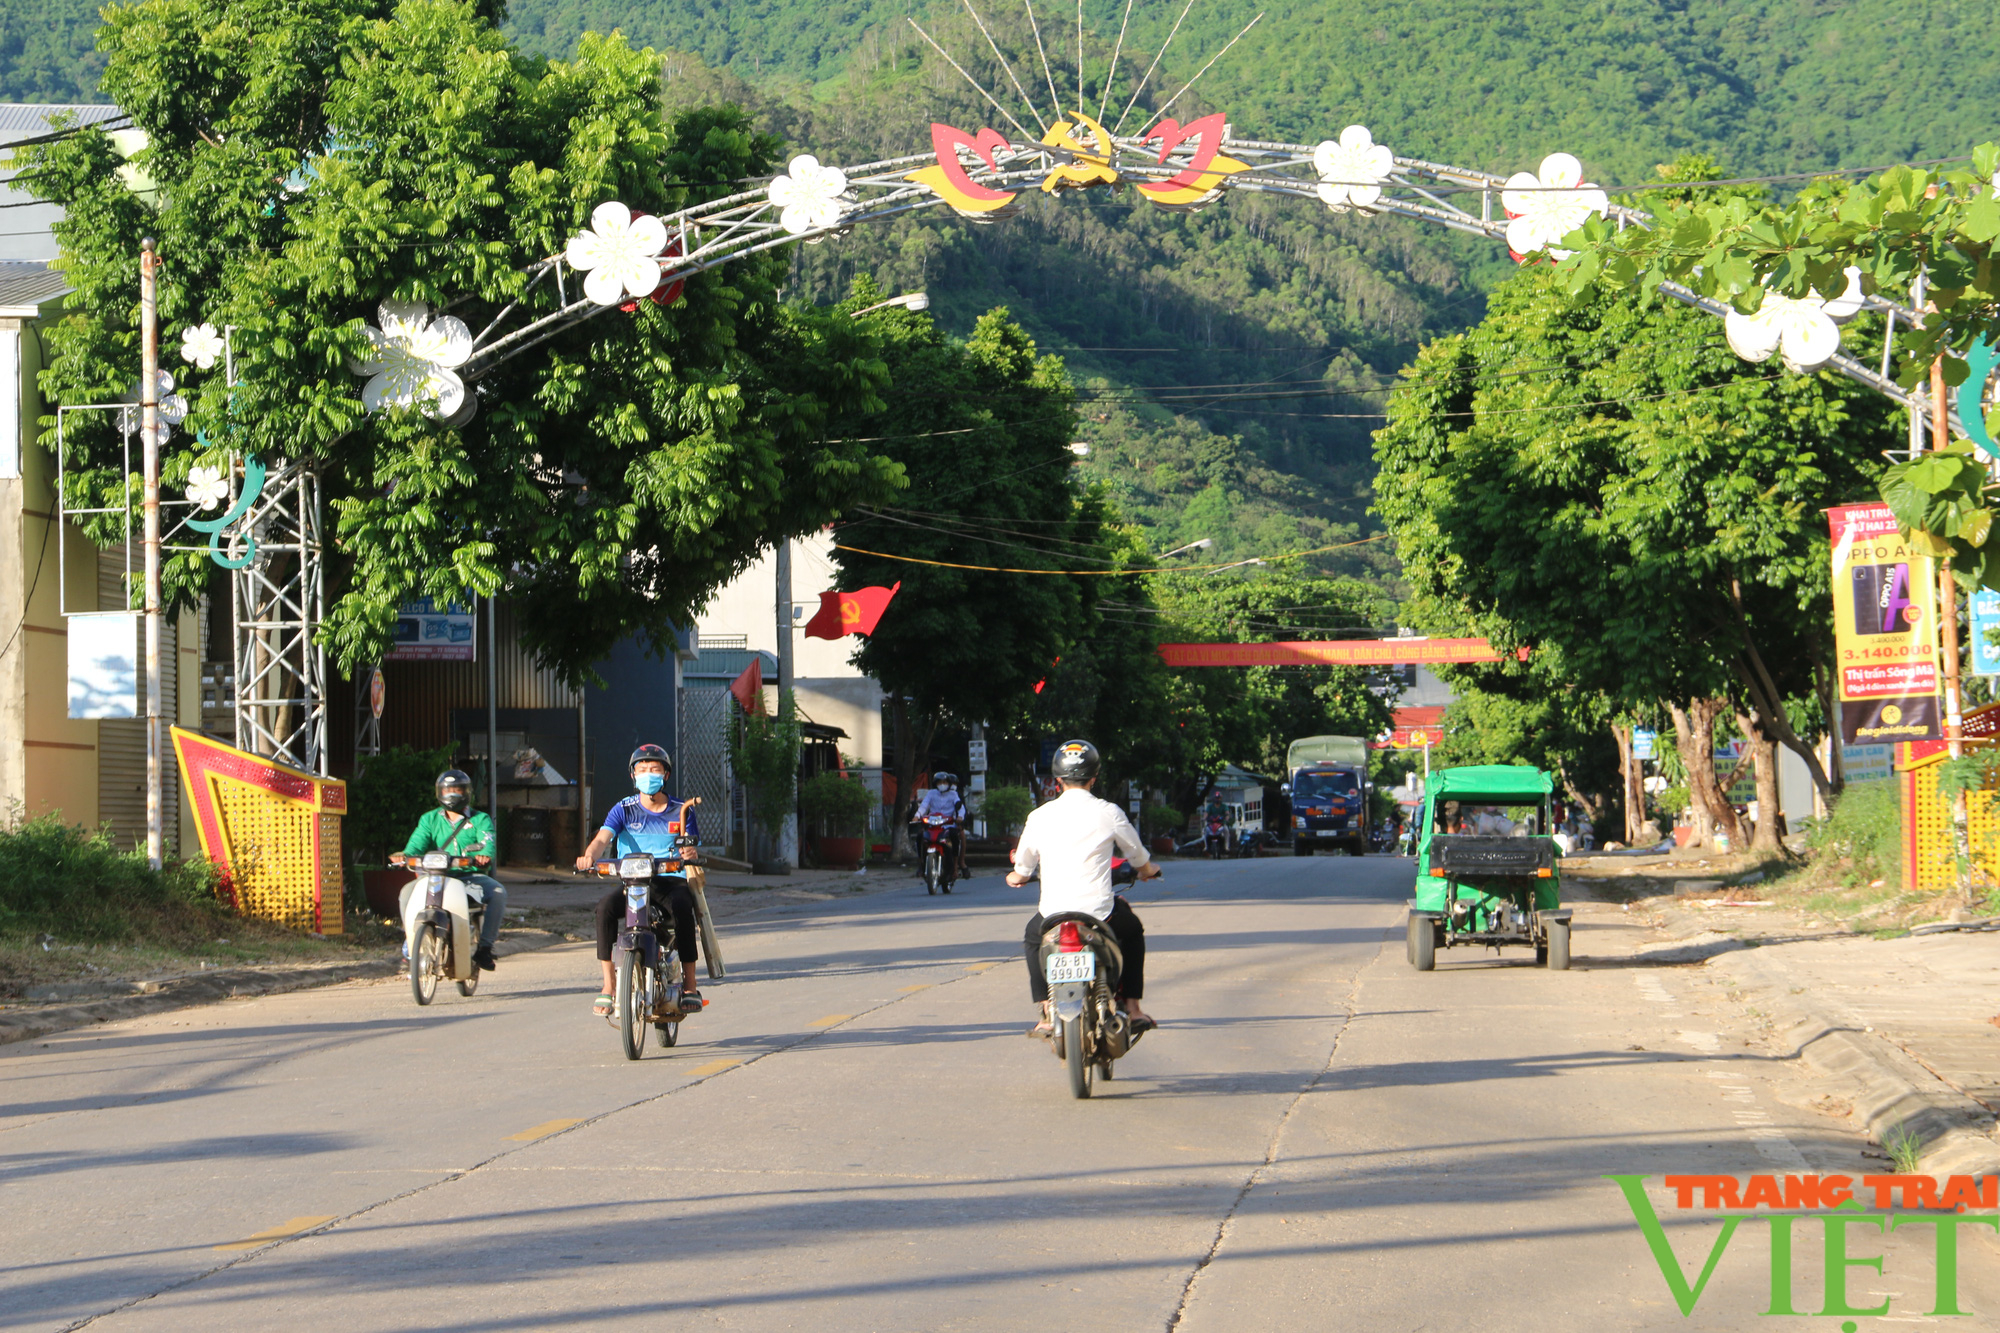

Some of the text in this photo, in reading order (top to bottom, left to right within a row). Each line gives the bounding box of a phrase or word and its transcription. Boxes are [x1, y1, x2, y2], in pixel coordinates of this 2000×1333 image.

[1866, 521, 1883, 531] HAI
[1880, 567, 1896, 608] OPPO A15
[1354, 646, 1372, 659] DÂN
[1396, 645, 1420, 659] CÔNG
[1450, 644, 1468, 658] VĂN
[1844, 645, 1932, 660] 3.140.000
[1845, 664, 1934, 682] Thị trấn Sông Mã
[1055, 955, 1086, 967] 26-B1
[1051, 967, 1090, 980] 999.07
